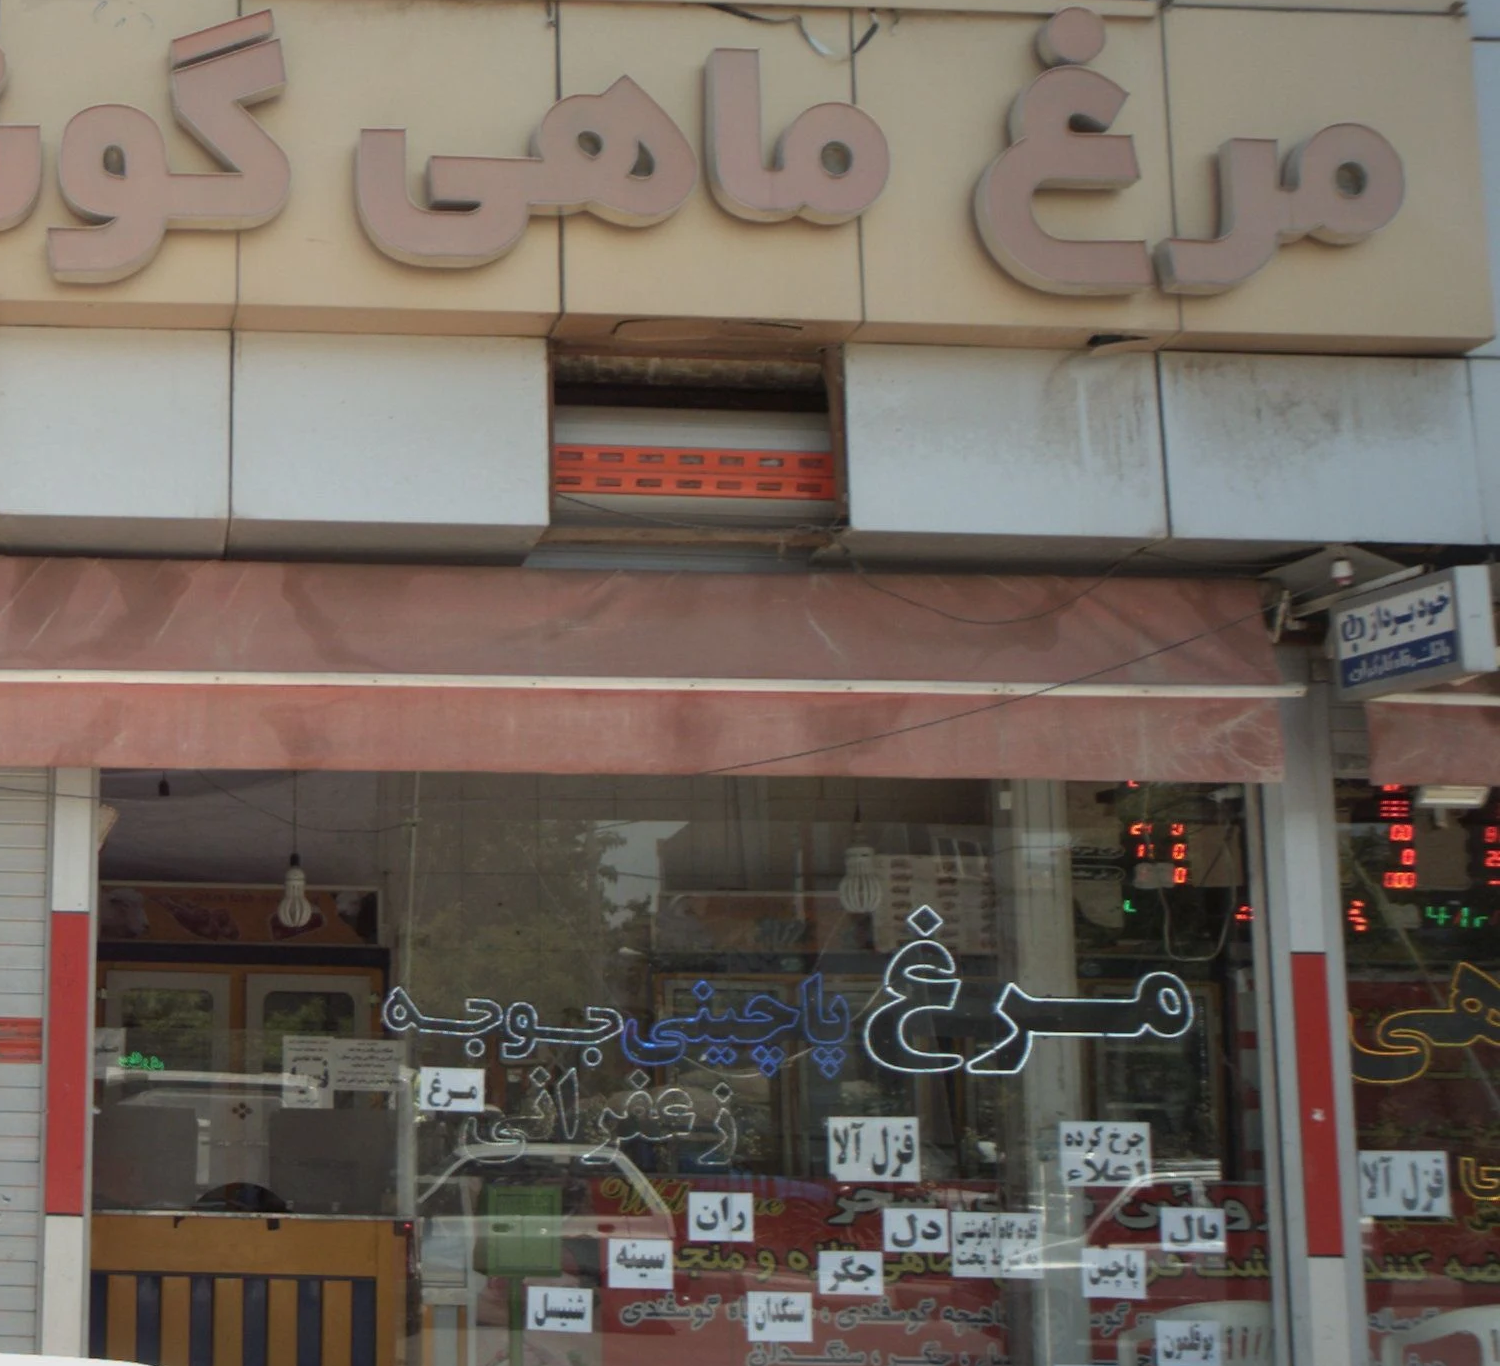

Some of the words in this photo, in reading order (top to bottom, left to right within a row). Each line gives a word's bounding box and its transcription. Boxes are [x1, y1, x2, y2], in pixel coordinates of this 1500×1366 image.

[355, 46, 891, 272] ماهی
[974, 6, 1406, 297] مرغ
[864, 903, 1195, 1074] مرغ
[382, 986, 625, 1067] جوجه
[426, 1072, 478, 1107] مرغ
[462, 1065, 738, 1166] زعفرانی
[832, 1121, 865, 1166] آلا
[871, 1123, 915, 1177] قزل
[1108, 1126, 1145, 1155] چرخ
[1361, 1155, 1393, 1200] آلا
[1402, 1157, 1444, 1212] قزل
[695, 1195, 747, 1233] ران
[890, 1212, 943, 1249] دل
[614, 1242, 666, 1278] سینه
[827, 1257, 877, 1293] جگر
[532, 1293, 587, 1328] شنیسل
[620, 1294, 722, 1330] گوسفندی
[753, 1296, 805, 1331] سنگدان
[1163, 1323, 1215, 1361] بوقلمون
